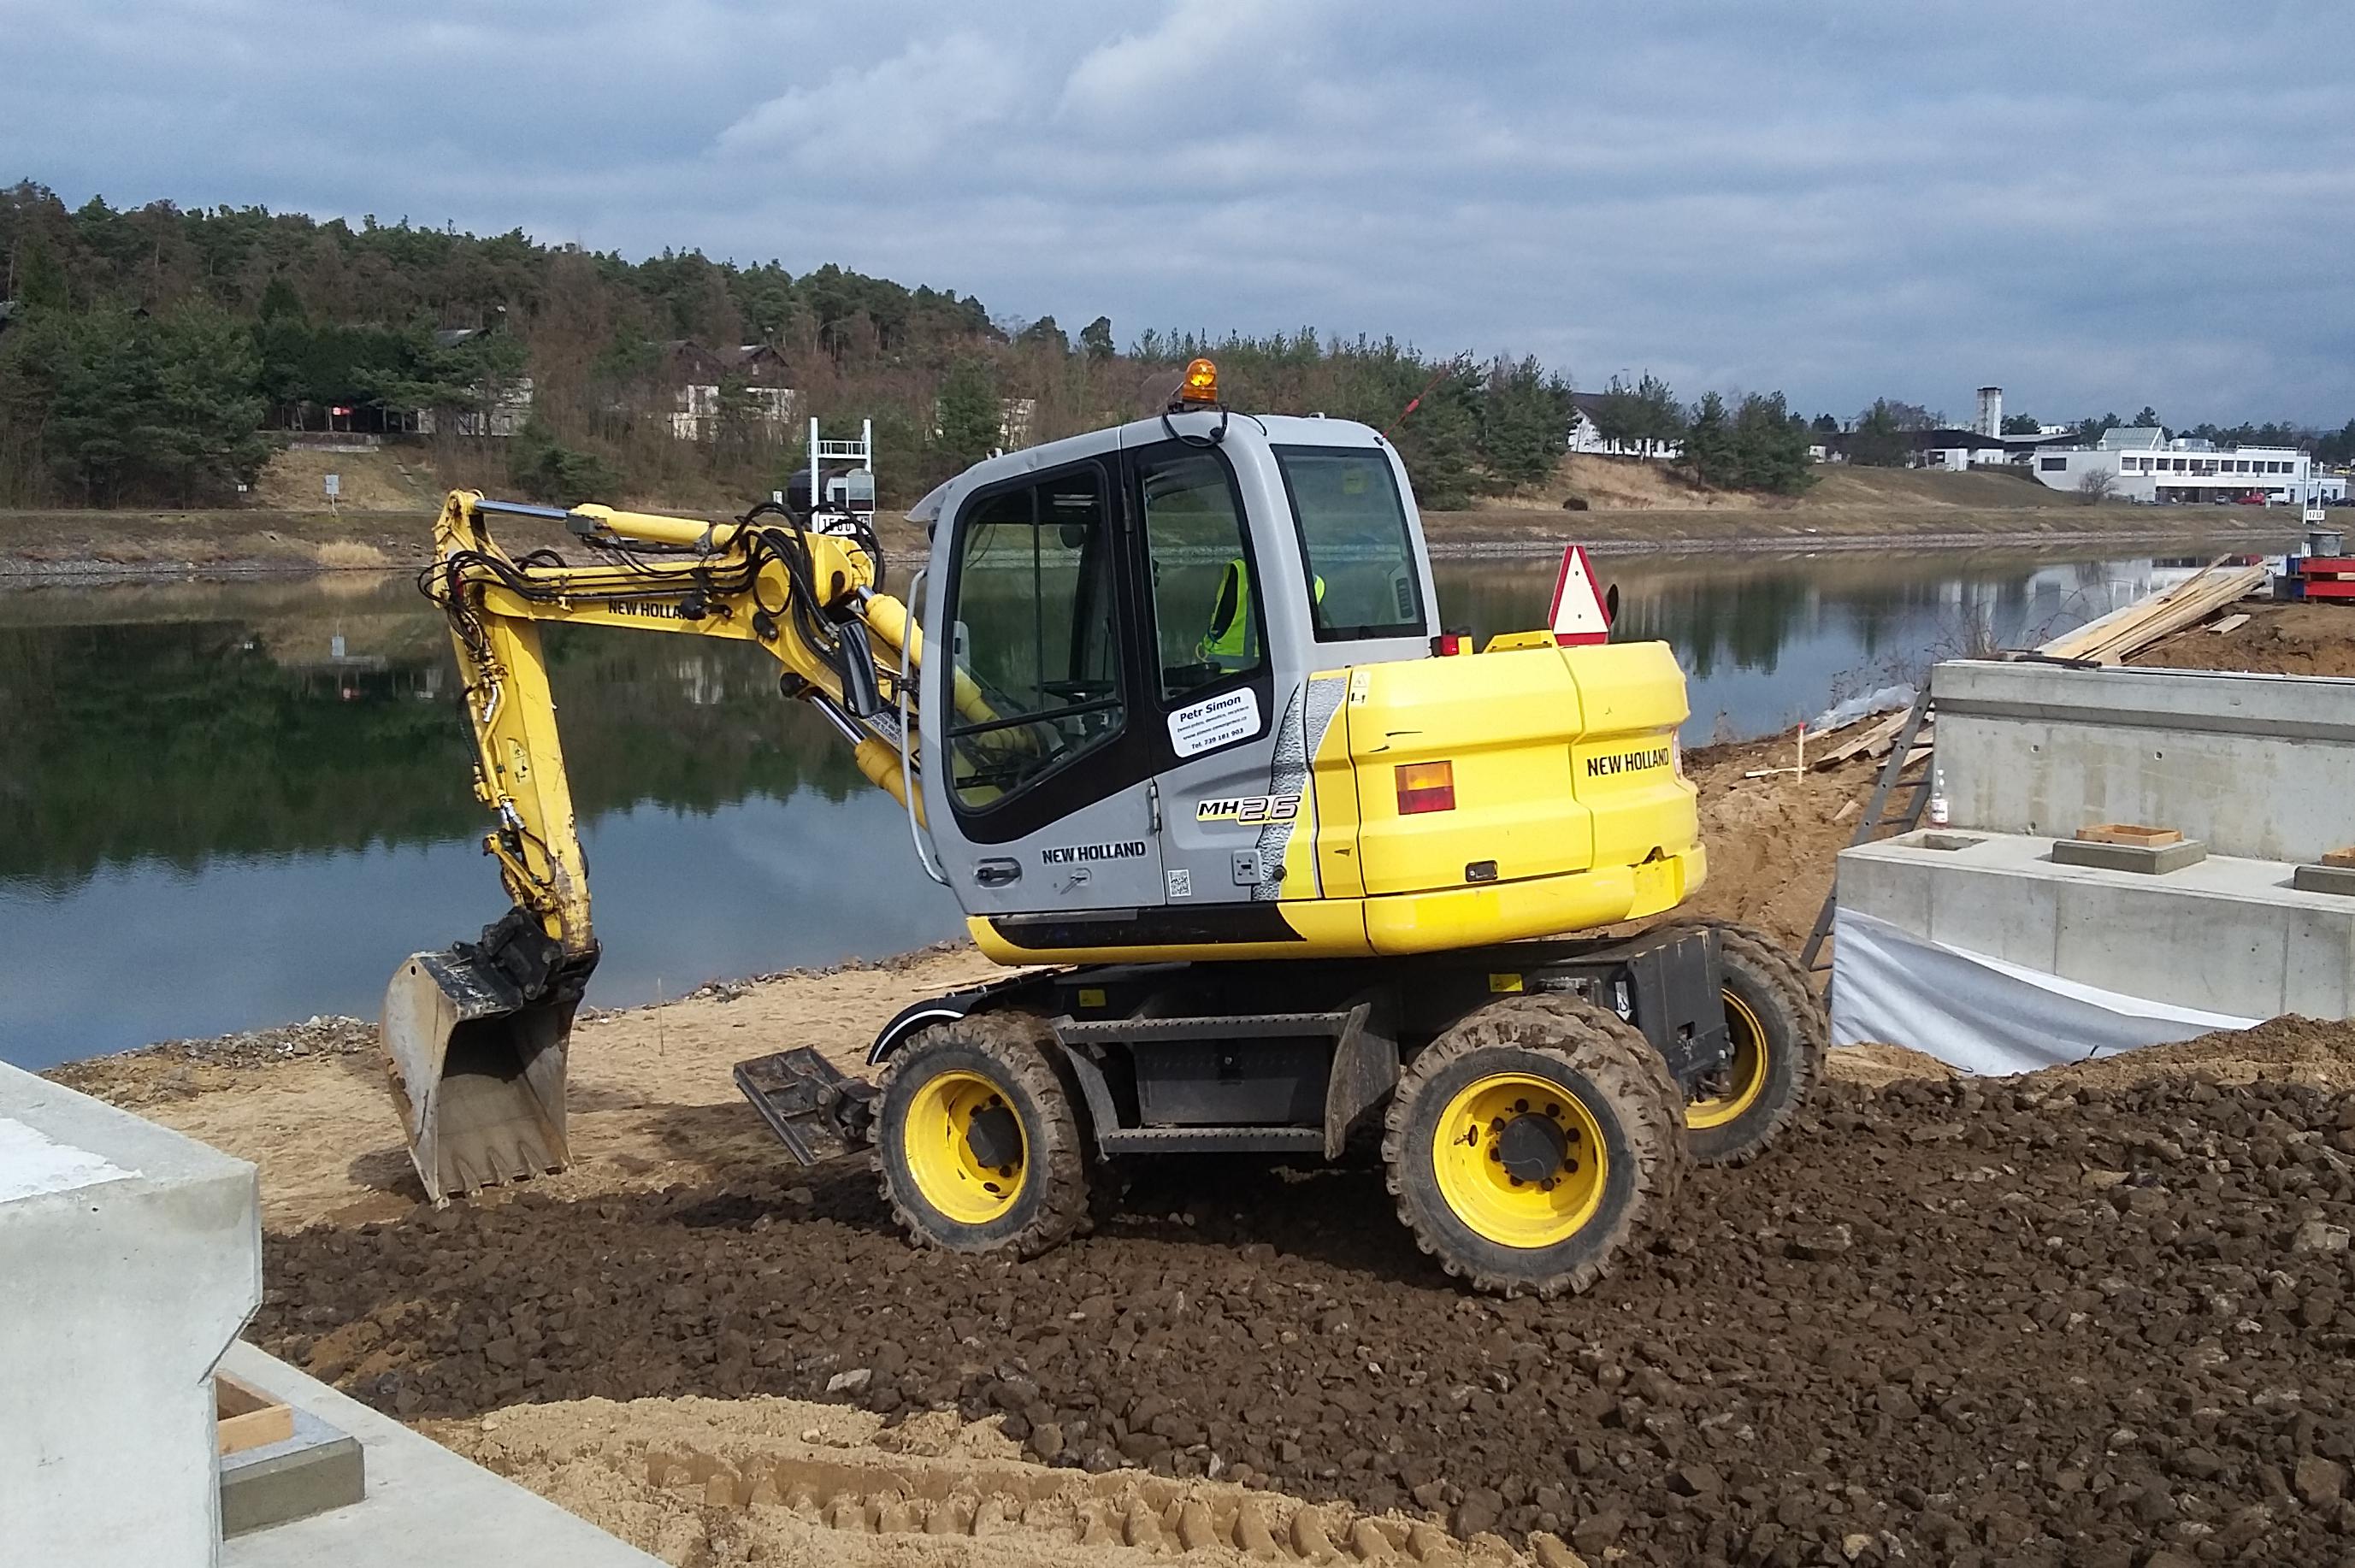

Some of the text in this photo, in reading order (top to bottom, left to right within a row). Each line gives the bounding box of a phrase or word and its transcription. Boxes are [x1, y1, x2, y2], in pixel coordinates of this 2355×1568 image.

[608, 599, 686, 620] NEW HOLLA
[1180, 696, 1241, 722] Petr Simon
[1204, 737, 1216, 746] 739
[1218, 732, 1229, 741] 181
[1586, 747, 1669, 777] NEW HOLLAND
[1042, 841, 1146, 864] NEW HOLLAND
